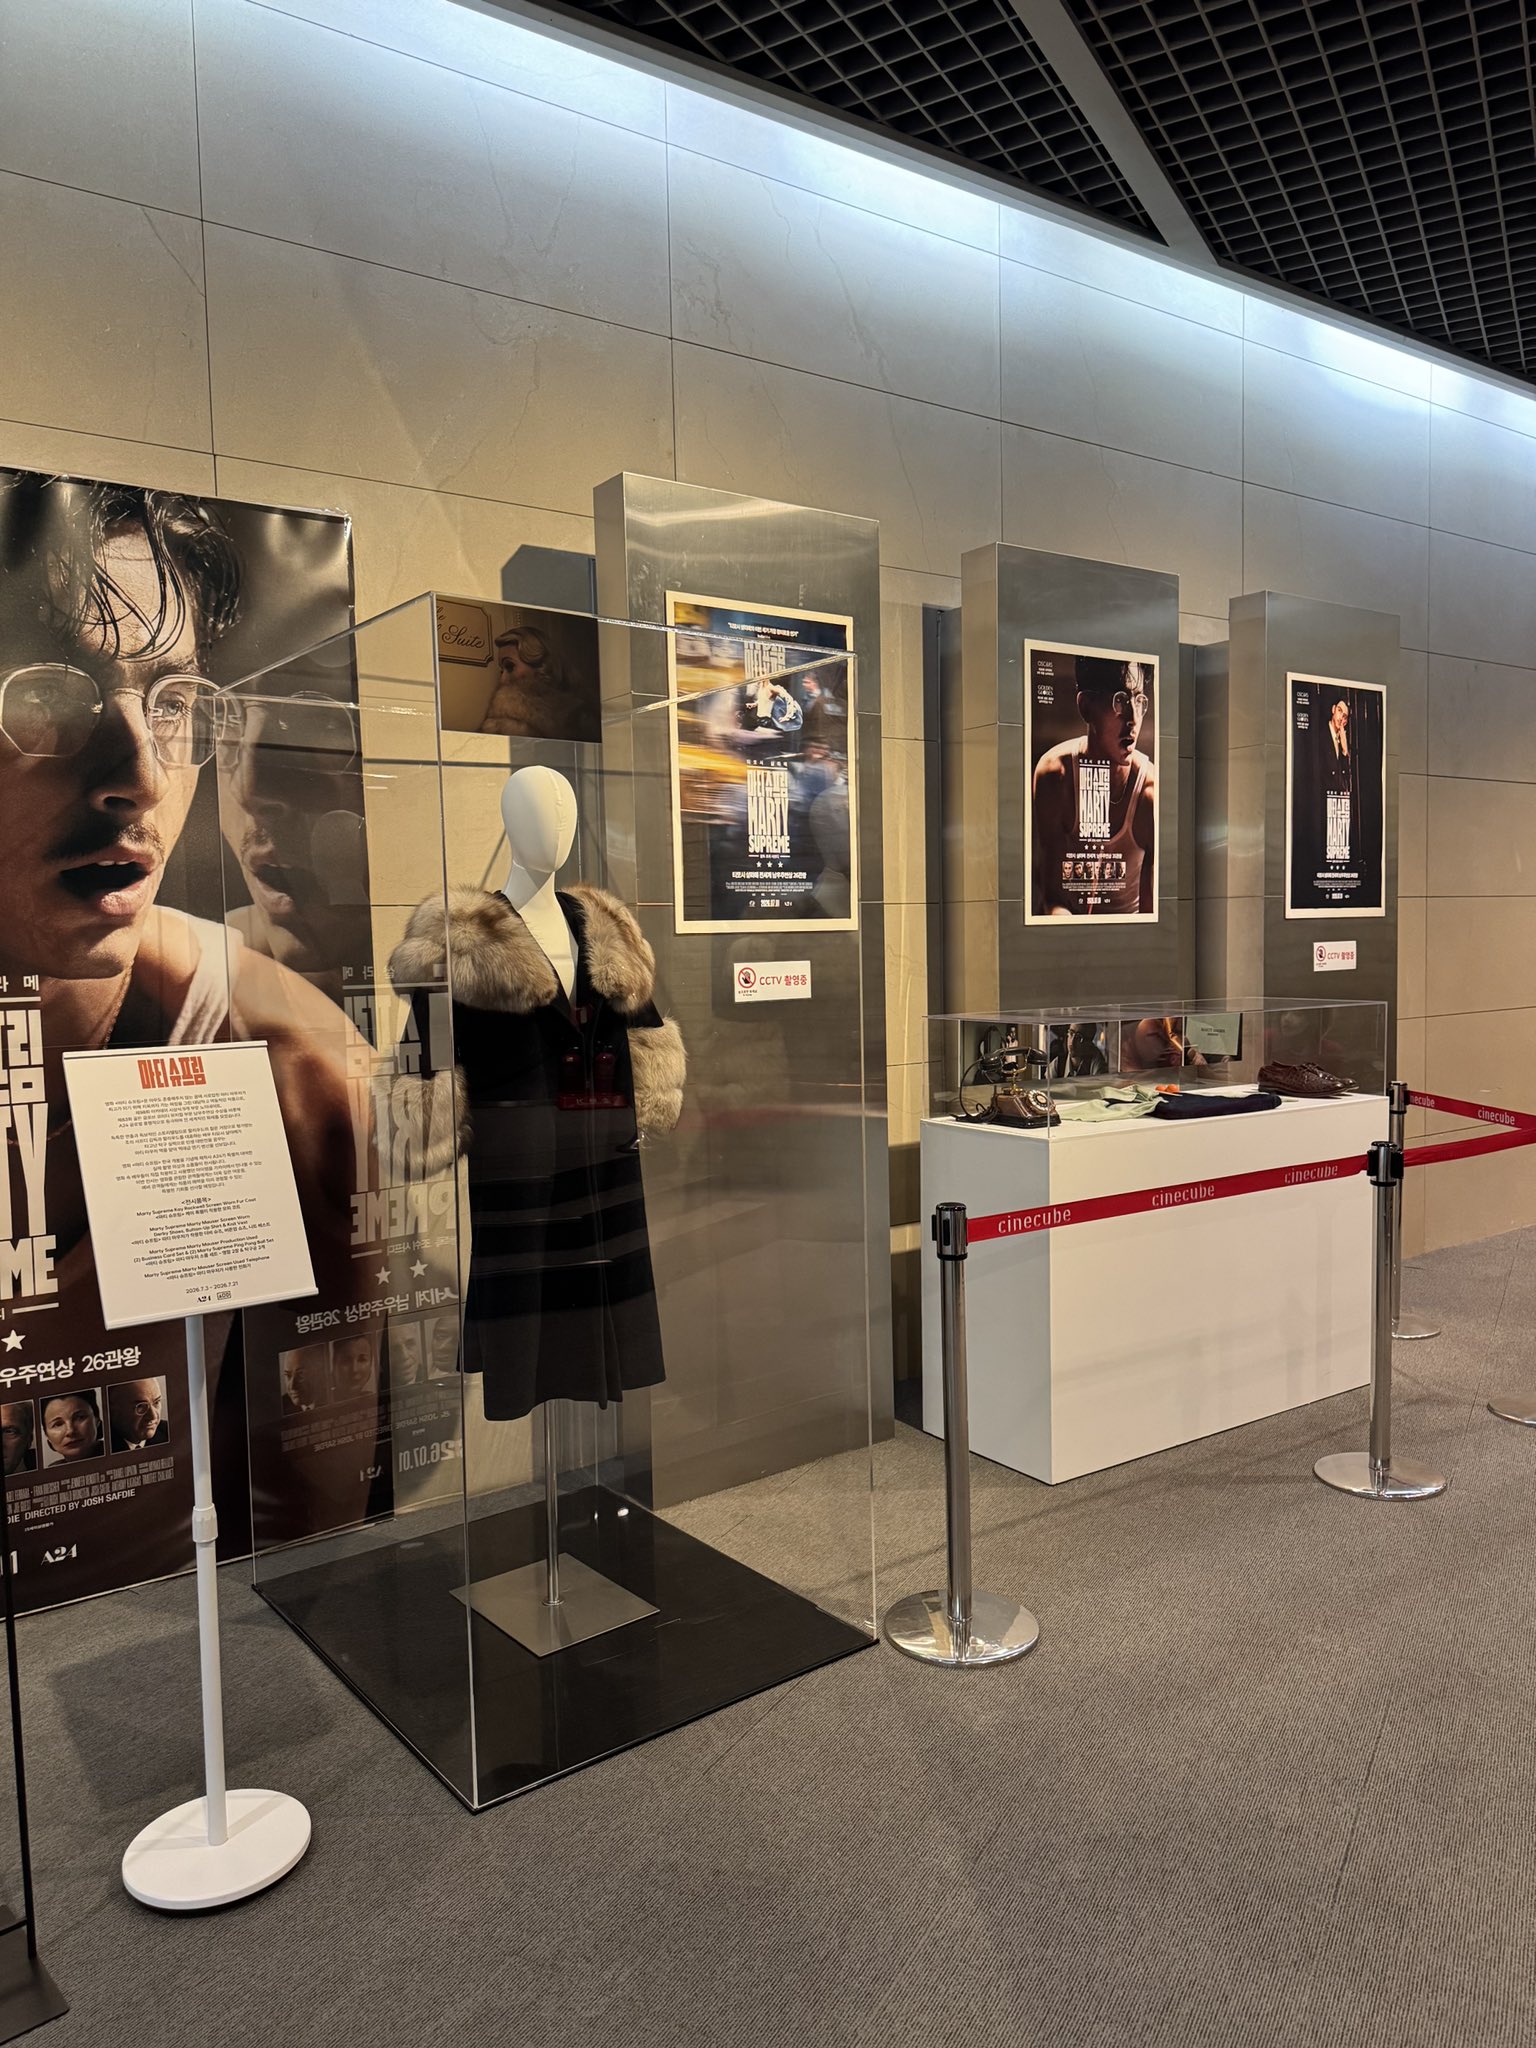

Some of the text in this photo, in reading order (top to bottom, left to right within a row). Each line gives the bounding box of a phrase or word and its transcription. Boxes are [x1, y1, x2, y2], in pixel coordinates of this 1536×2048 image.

[442, 625, 486, 648] Suite
[748, 797, 789, 836] MARTY
[1079, 790, 1110, 823] MARTY
[1079, 822, 1110, 838] SUPREME
[1327, 817, 1350, 846] MARTY
[748, 835, 790, 854] SUPREME
[1327, 952, 1340, 960] CCTV
[759, 974, 807, 986] CCTV 촬영중
[138, 1055, 206, 1089] 마티슈프림
[1478, 1107, 1516, 1125] cinecube
[998, 1165, 1338, 1234] cinecube cinecube cinecube
[82, 1346, 141, 1373] 26관왕
[24, 1502, 66, 1520] DIRECTED
[68, 1501, 80, 1511] BY
[82, 1493, 104, 1508] JOSH
[105, 1489, 136, 1502] SAFDIE
[41, 1544, 78, 1566] A24
